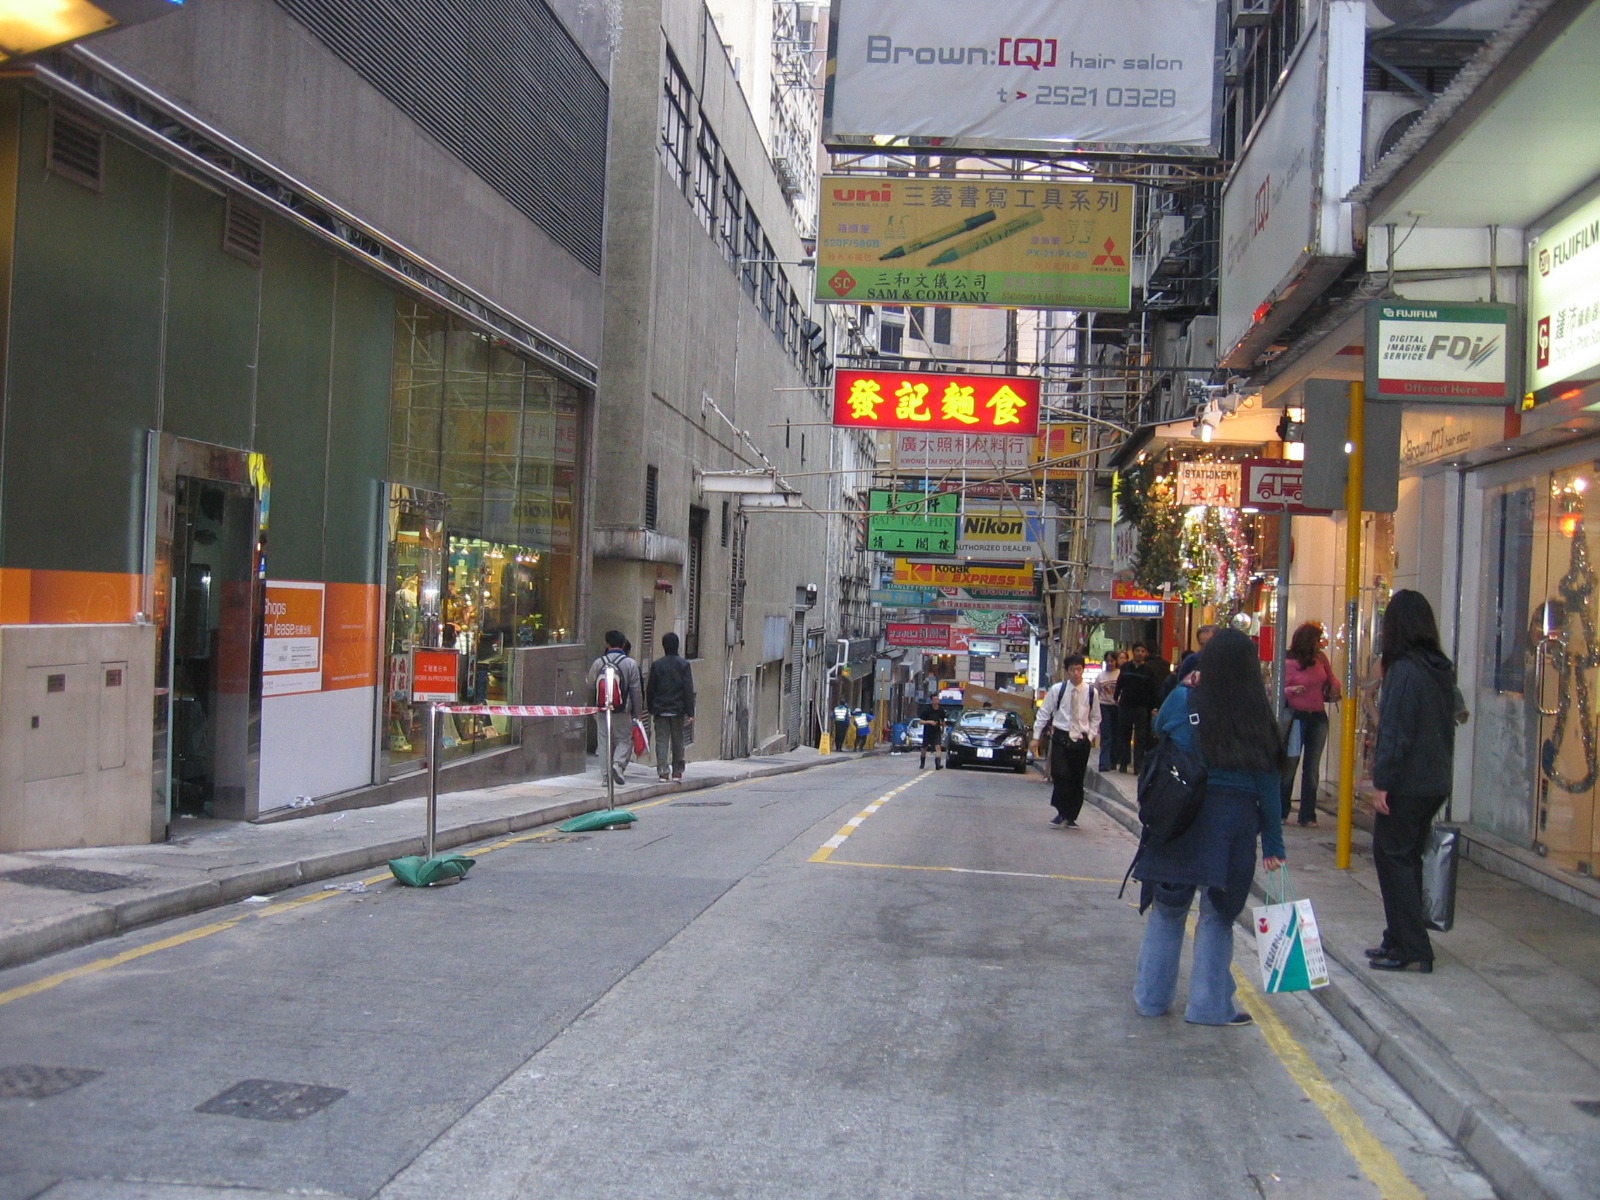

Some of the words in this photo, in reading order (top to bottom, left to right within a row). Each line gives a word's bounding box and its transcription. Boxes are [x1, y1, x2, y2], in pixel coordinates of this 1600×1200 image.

[1070, 51, 1115, 69] hair
[1123, 53, 1182, 71] salon
[1035, 85, 1097, 106] 2521
[1105, 86, 1176, 108] 0328
[833, 183, 892, 202] uni
[903, 186, 1119, 213] 三菱書寫工具系列
[875, 272, 987, 291] 三和文儀公司
[867, 288, 897, 300] SAM
[902, 289, 912, 300] &
[920, 289, 989, 302] COMPANY
[1396, 309, 1437, 318] FUJIFILM
[1389, 335, 1424, 343] DIGITAL
[1387, 344, 1426, 352] IMAGING
[1383, 352, 1424, 361] SERVICE
[1404, 382, 1447, 394] Offered
[1451, 384, 1478, 395] Here
[847, 379, 1027, 426] 發記麵食
[902, 436, 1025, 454] 廣大照相材料行
[1185, 469, 1238, 480] STATIONERY
[1190, 483, 1231, 502] 文具
[928, 517, 954, 528] HIN
[964, 517, 1023, 535] Nikon
[956, 544, 1000, 552] AUTHORIZED
[934, 564, 970, 574] Kodak
[952, 573, 1016, 585] EXPRESS
[1120, 604, 1160, 614] RESTAURANT
[274, 619, 295, 636] lease
